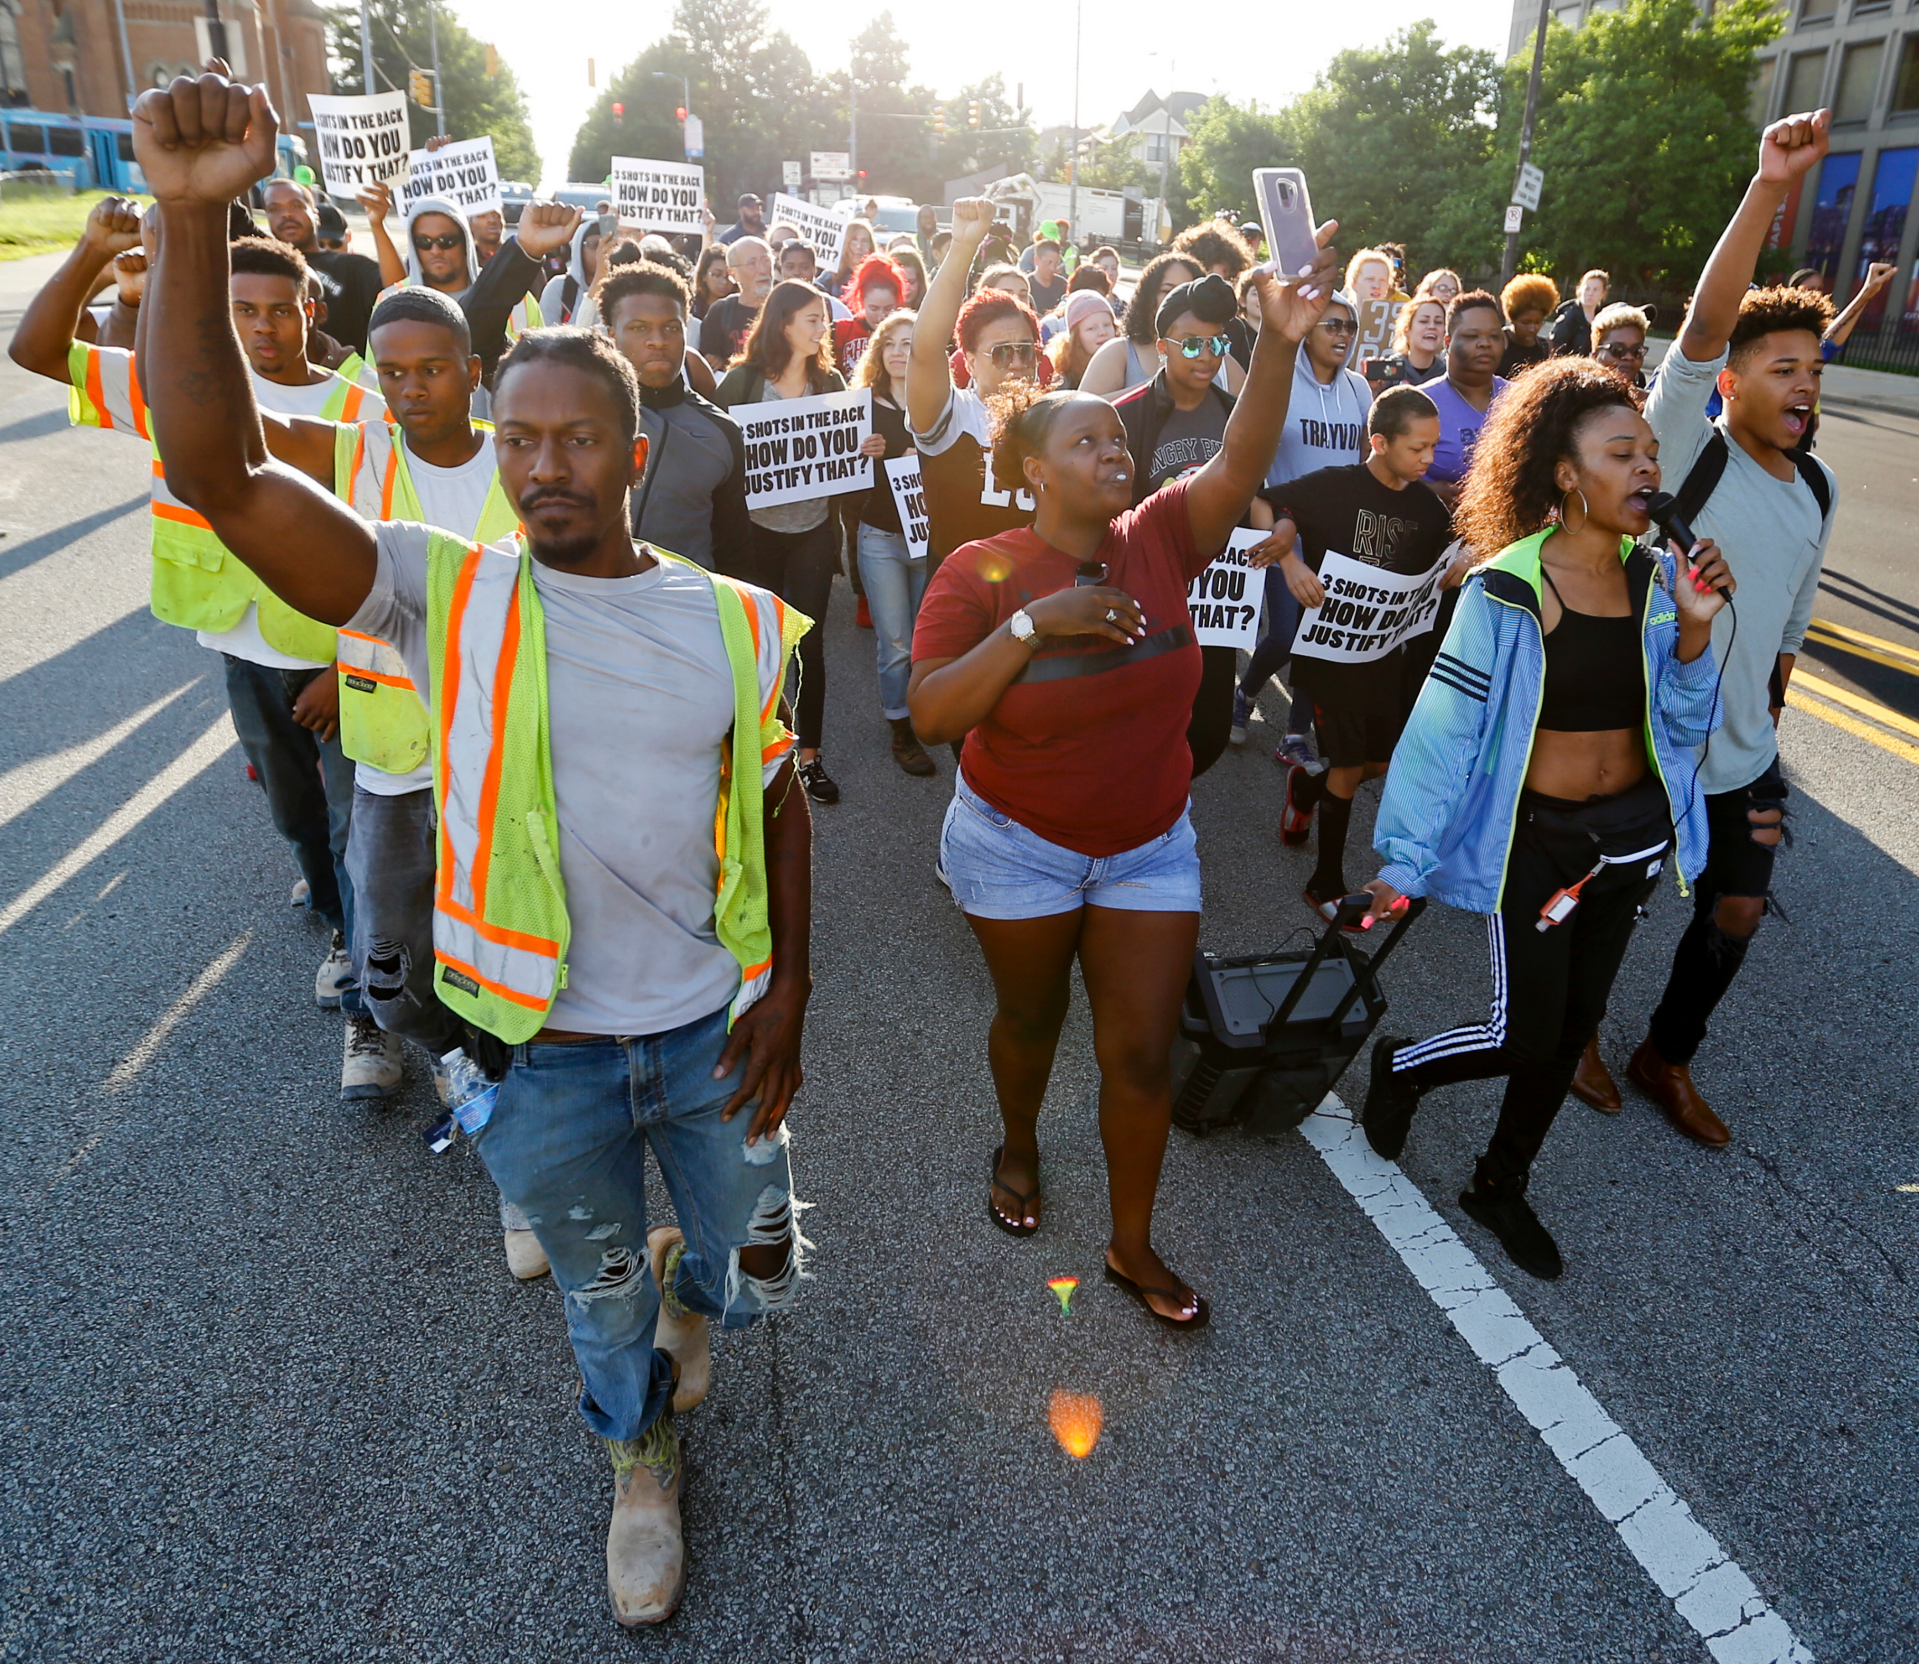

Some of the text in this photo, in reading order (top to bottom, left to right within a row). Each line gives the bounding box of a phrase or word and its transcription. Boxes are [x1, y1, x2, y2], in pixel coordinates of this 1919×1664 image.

[337, 113, 349, 130] IN
[349, 113, 376, 130] THE
[375, 107, 404, 127] BACK
[321, 128, 401, 160] HOW DO YOU
[324, 152, 409, 184] JUSTIFY THAT?
[410, 149, 489, 176] OTS IN THE BACK
[402, 164, 487, 199] HOW DO YOU
[614, 169, 701, 187] 3 SHOTS IN THE BACK
[456, 181, 497, 206] THAT?
[619, 183, 697, 207] HOW DO YOU
[666, 208, 703, 224] THAT?
[776, 203, 781, 213] 3
[781, 205, 801, 221] SHOTS
[801, 212, 809, 223] IN
[810, 214, 824, 228] THE
[823, 220, 843, 233] BACK
[814, 228, 837, 248] YOU
[814, 245, 839, 263] HAT?
[746, 417, 789, 439] SHOTS
[791, 415, 805, 432] IN
[806, 411, 831, 429] THE
[833, 405, 865, 425] BACK
[745, 426, 858, 471] HOW DO YOU
[1149, 437, 1197, 478] NGRY
[744, 452, 869, 496] JUSTIFY THAT?
[892, 477, 902, 491] 3
[1198, 567, 1246, 602] YOU
[1322, 573, 1333, 591] 3
[1332, 578, 1390, 605] SHOTS
[1388, 591, 1408, 605] IN
[1189, 604, 1255, 631] THAT?
[1317, 597, 1380, 631] HOW
[1377, 607, 1409, 631] DO
[1649, 611, 1677, 626] adida
[1301, 623, 1393, 651] JUSTIFY
